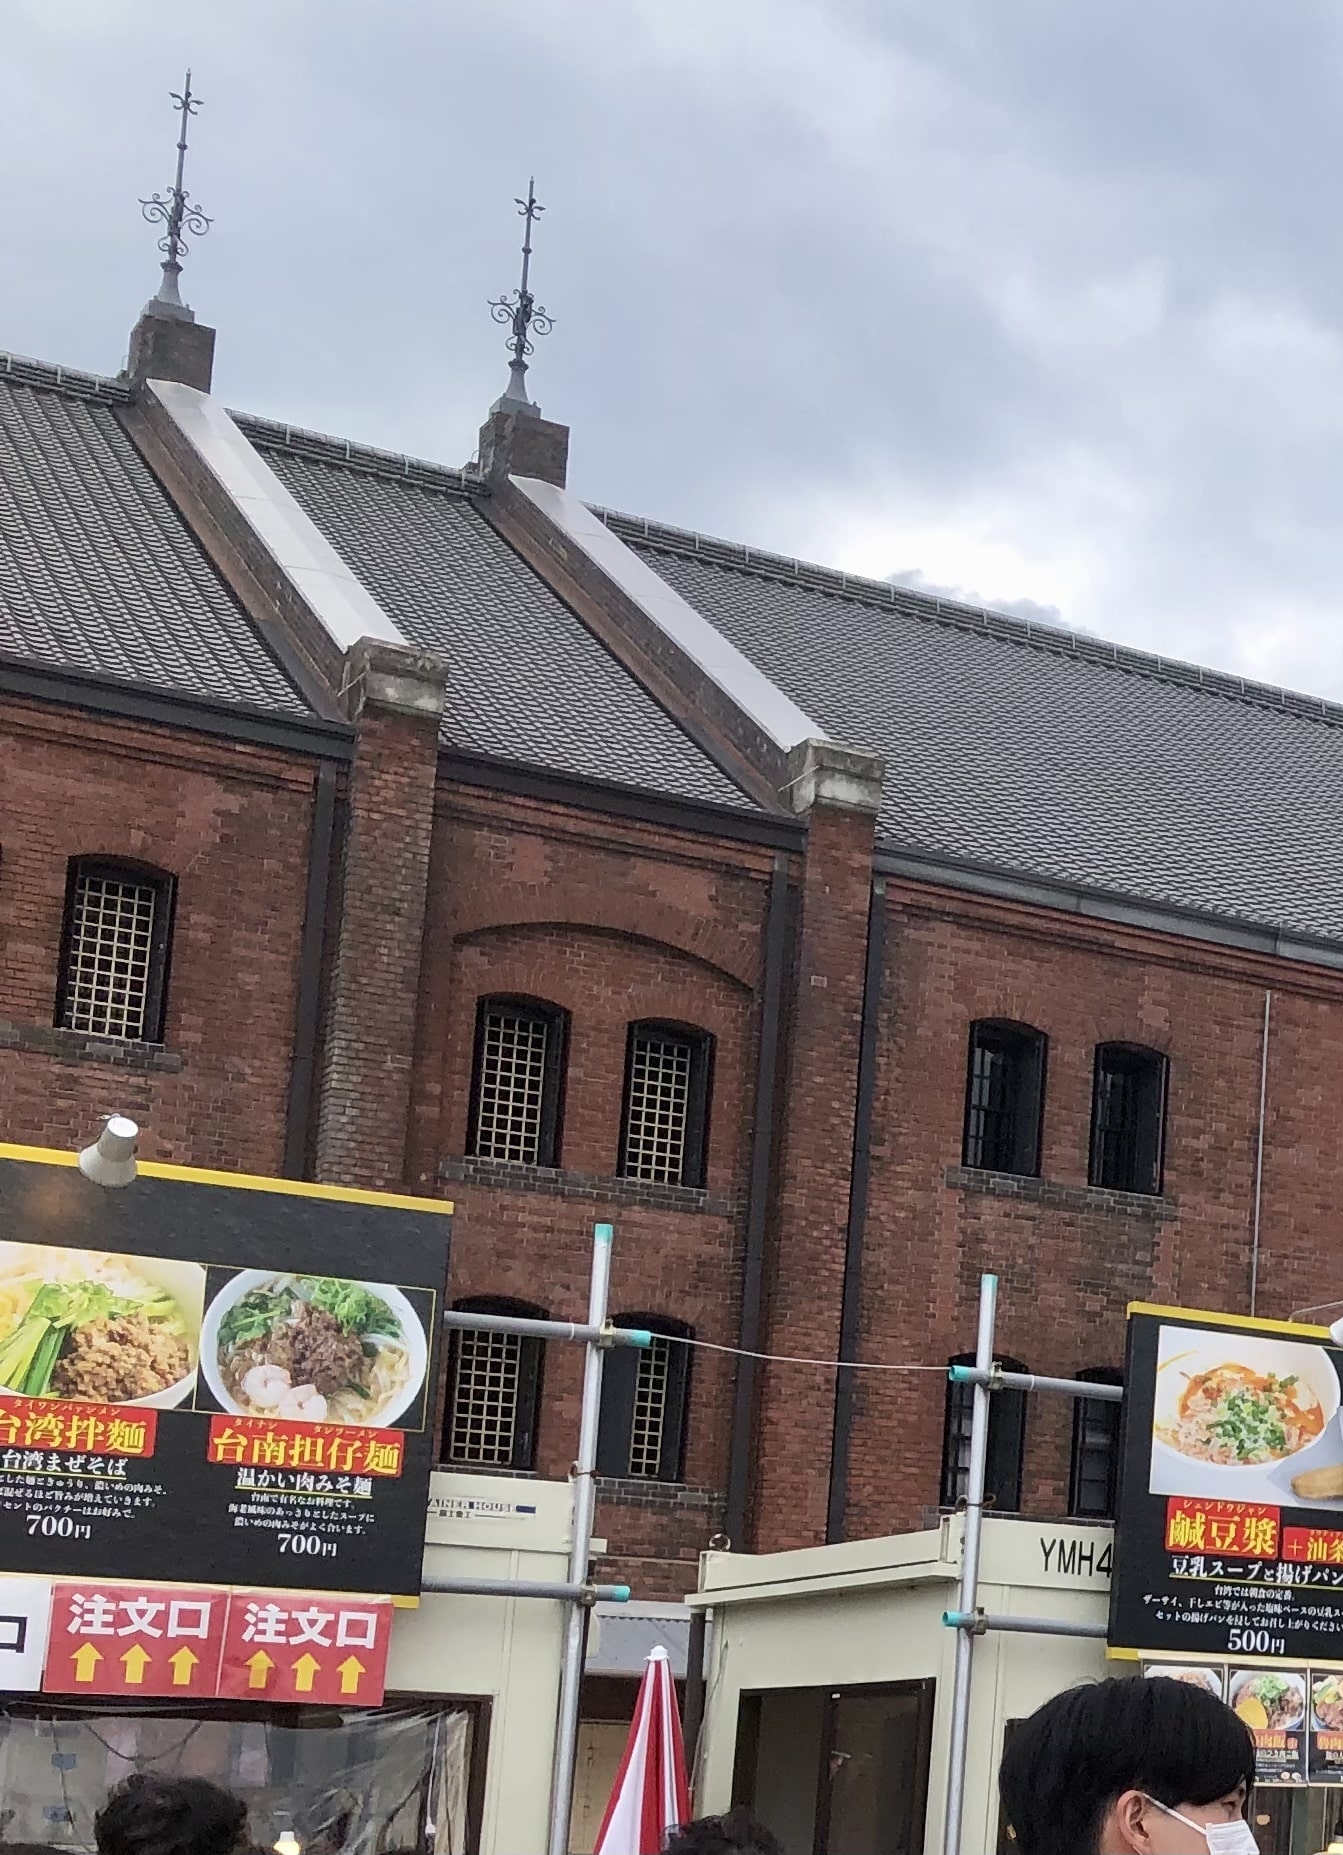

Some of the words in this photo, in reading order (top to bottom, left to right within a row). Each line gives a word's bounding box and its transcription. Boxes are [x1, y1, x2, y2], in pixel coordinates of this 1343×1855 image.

[234, 1418, 278, 1429] タイナン
[2, 1449, 128, 1476] 台湾まぜそば
[237, 1467, 373, 1495] 温かい肉みそ麺
[26, 1514, 92, 1539] 700円
[277, 1533, 338, 1557] 700円
[67, 1593, 212, 1639] 注文口
[241, 1603, 377, 1649] 注文口
[1227, 1629, 1286, 1654] 500円
